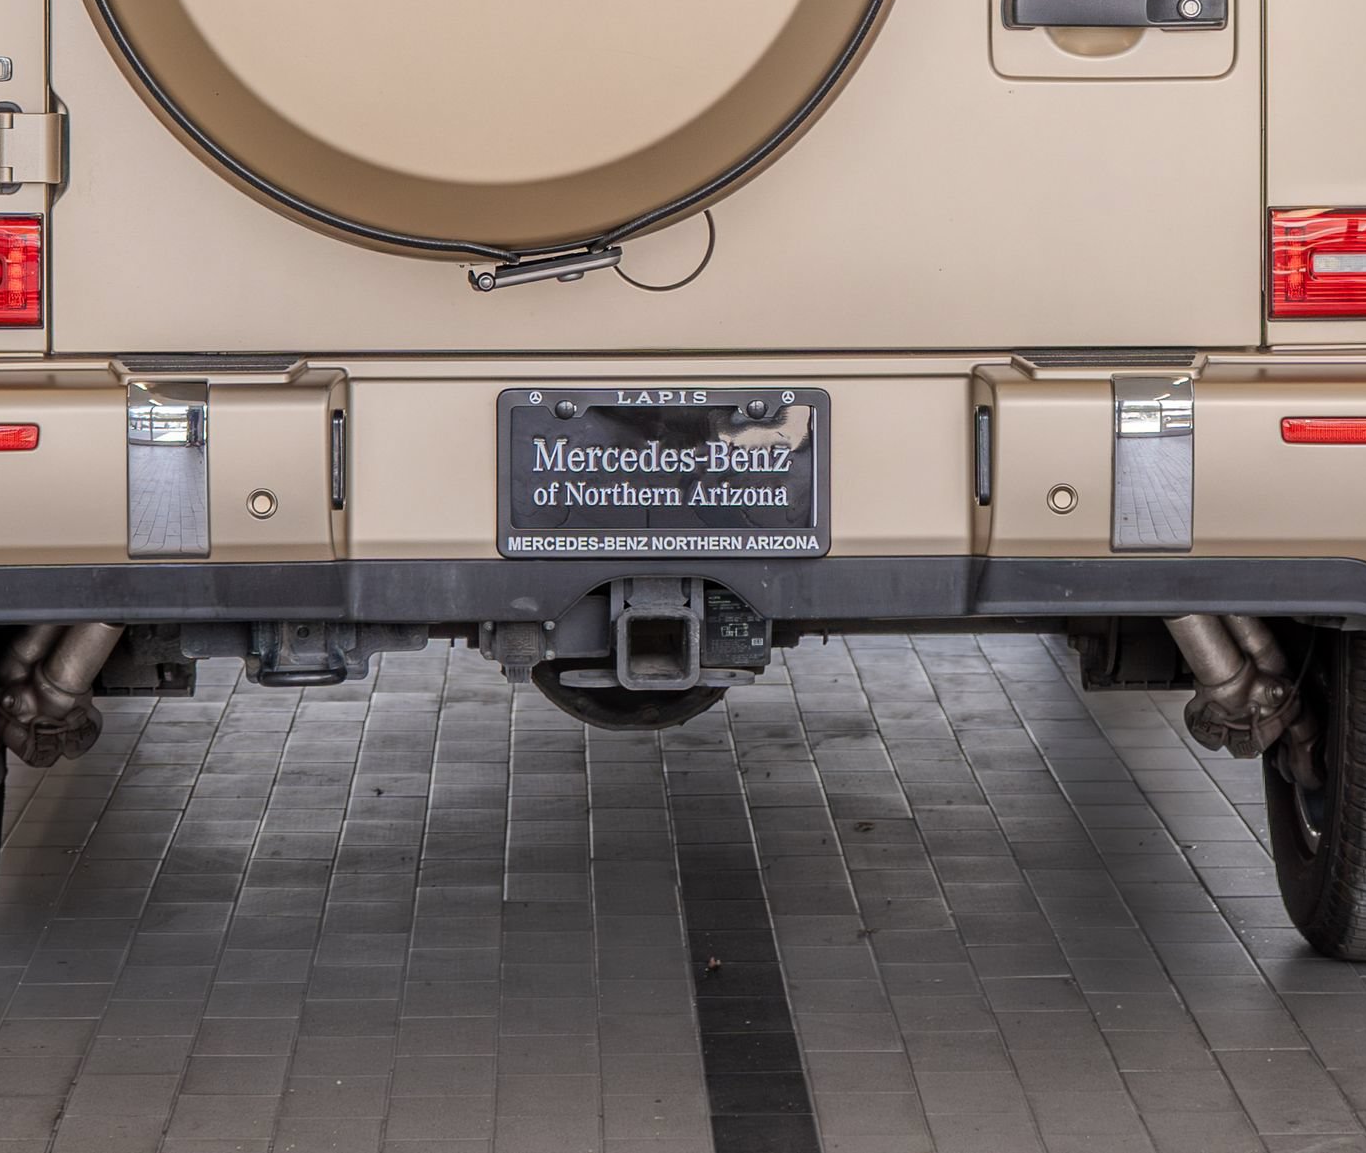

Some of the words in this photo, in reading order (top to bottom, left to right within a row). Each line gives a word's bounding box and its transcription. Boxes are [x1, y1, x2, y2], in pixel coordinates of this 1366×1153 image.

[617, 391, 707, 404] LAPIS
[533, 439, 792, 472] Mercedes-Benz
[533, 482, 560, 506] of
[565, 481, 682, 506] Northern
[688, 481, 789, 506] Arizona
[508, 537, 648, 551] MERCEDES-BENZ
[652, 536, 742, 551] NORTHERN
[746, 535, 820, 550] ARIZONA
